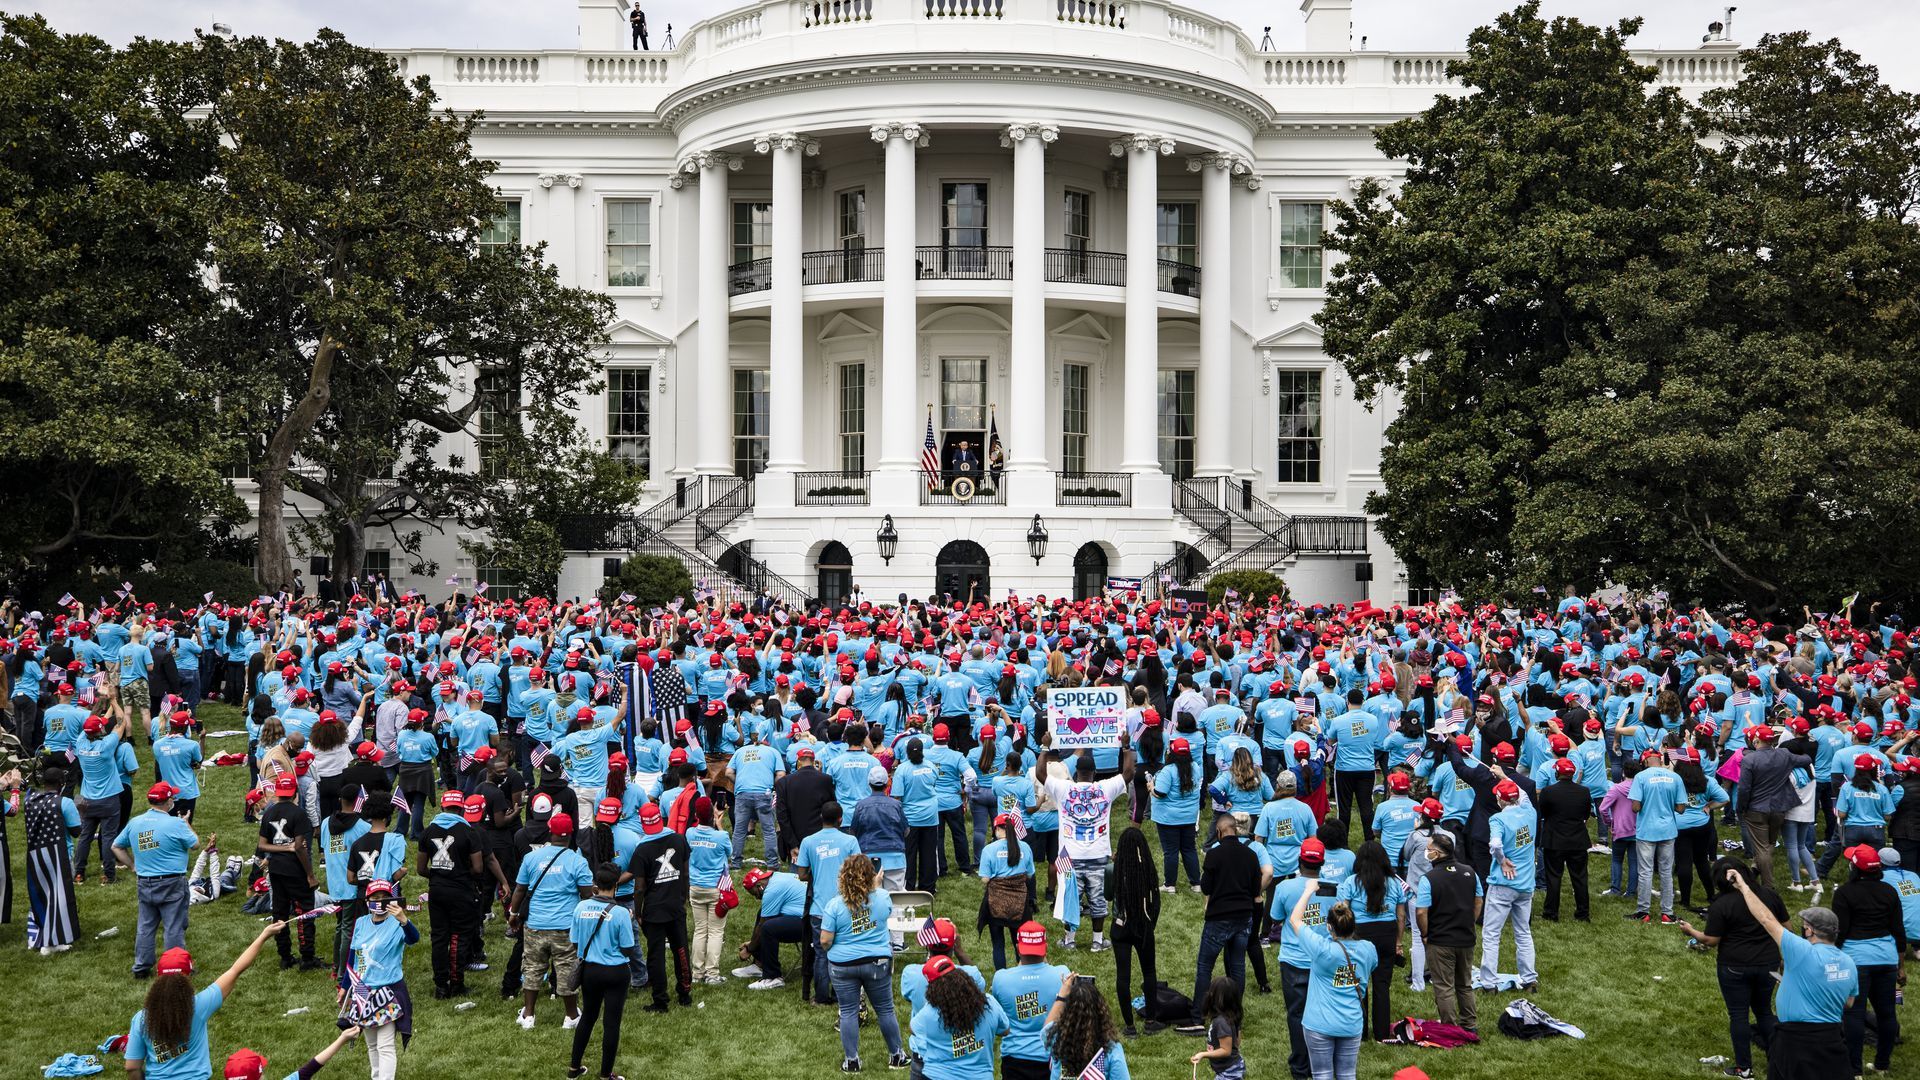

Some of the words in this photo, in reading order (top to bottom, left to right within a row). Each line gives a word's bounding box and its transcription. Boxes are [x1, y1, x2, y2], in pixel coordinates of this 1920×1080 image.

[1054, 692, 1118, 707] SPREAD
[1079, 708, 1097, 716] THE
[1060, 736, 1116, 745] MOVEMENT
[362, 986, 394, 1018] BLUE
[1016, 991, 1038, 1004] BLEXIT
[1017, 1000, 1039, 1012] BACKS
[1017, 1011, 1030, 1020] THE
[1031, 1004, 1048, 1017] BLUE
[953, 1036, 976, 1048] BACKS
[954, 1047, 967, 1058] THE
[968, 1039, 984, 1053] BLUE
